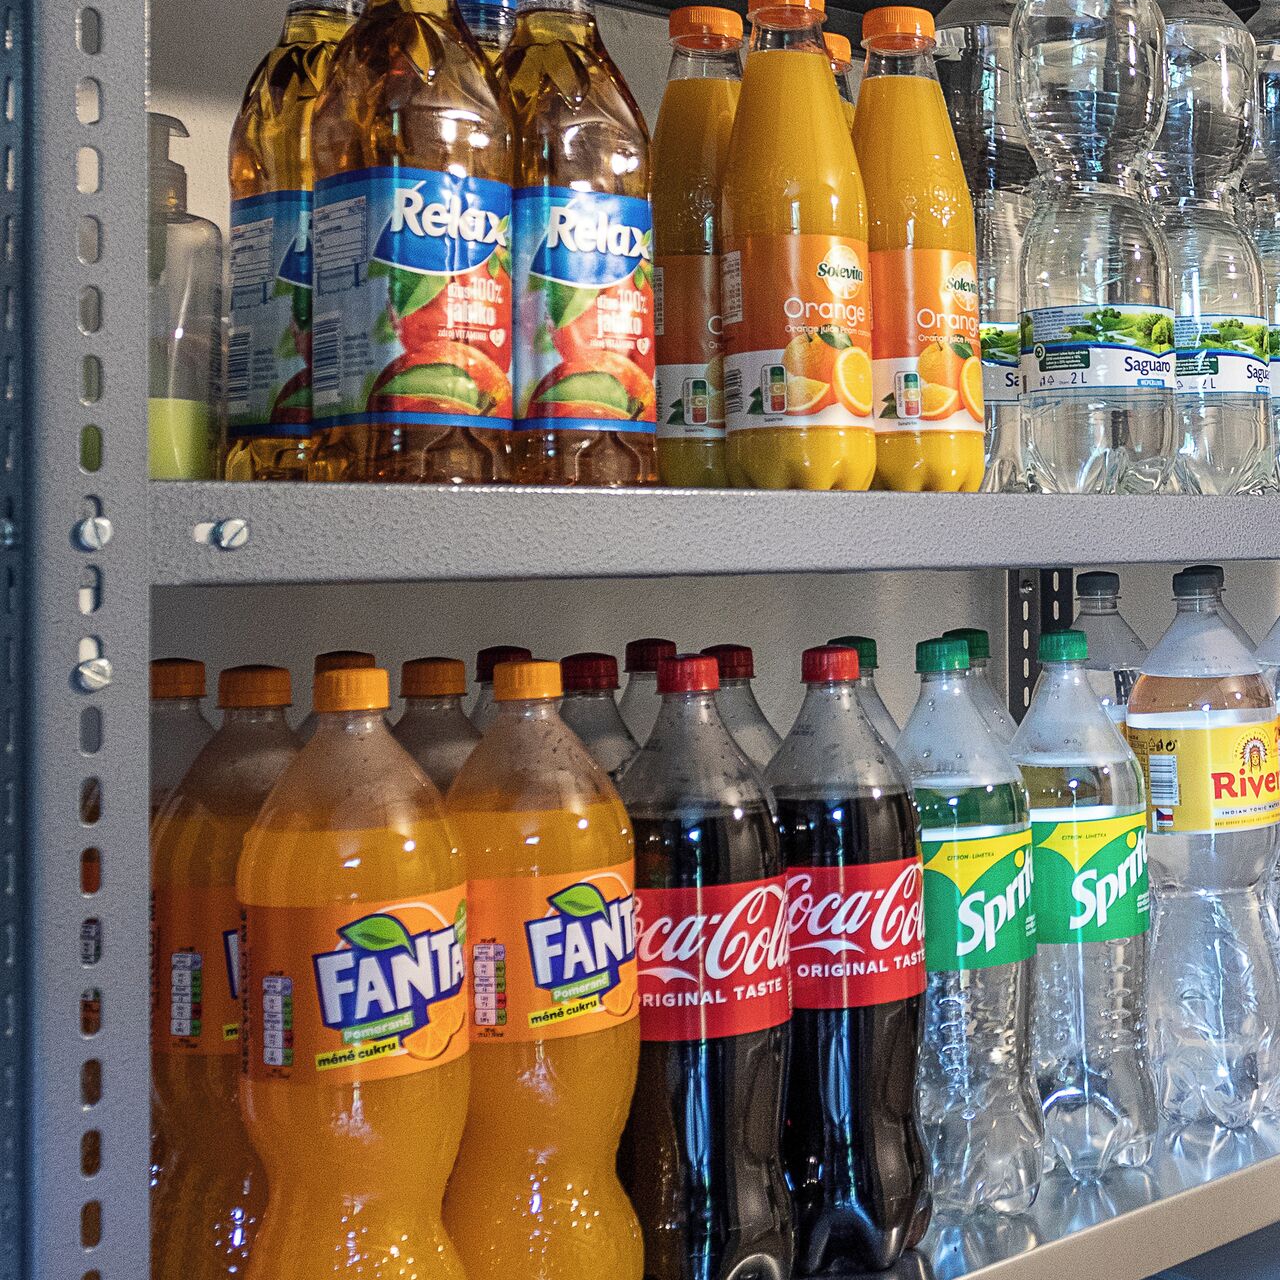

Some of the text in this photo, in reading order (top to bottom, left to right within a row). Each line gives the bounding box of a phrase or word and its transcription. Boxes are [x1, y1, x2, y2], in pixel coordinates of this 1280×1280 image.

[390, 180, 509, 247] Relax
[547, 198, 650, 260] Relax
[946, 277, 978, 295] Solevi
[784, 297, 865, 326] Orange
[785, 324, 818, 336] Orange
[820, 324, 839, 336] juice
[1071, 372, 1087, 384] 2 L
[1125, 356, 1171, 376] Saguaro
[1069, 828, 1148, 930] Sprit
[956, 845, 1034, 956] Sprit
[528, 897, 635, 986] FANT
[316, 928, 465, 1025] FANTA
[797, 959, 889, 978] ORIGINAL
[642, 976, 783, 1008] RIGINAL TASTE
[530, 999, 598, 1024] méně cukru
[317, 1042, 397, 1067] méně cukru
